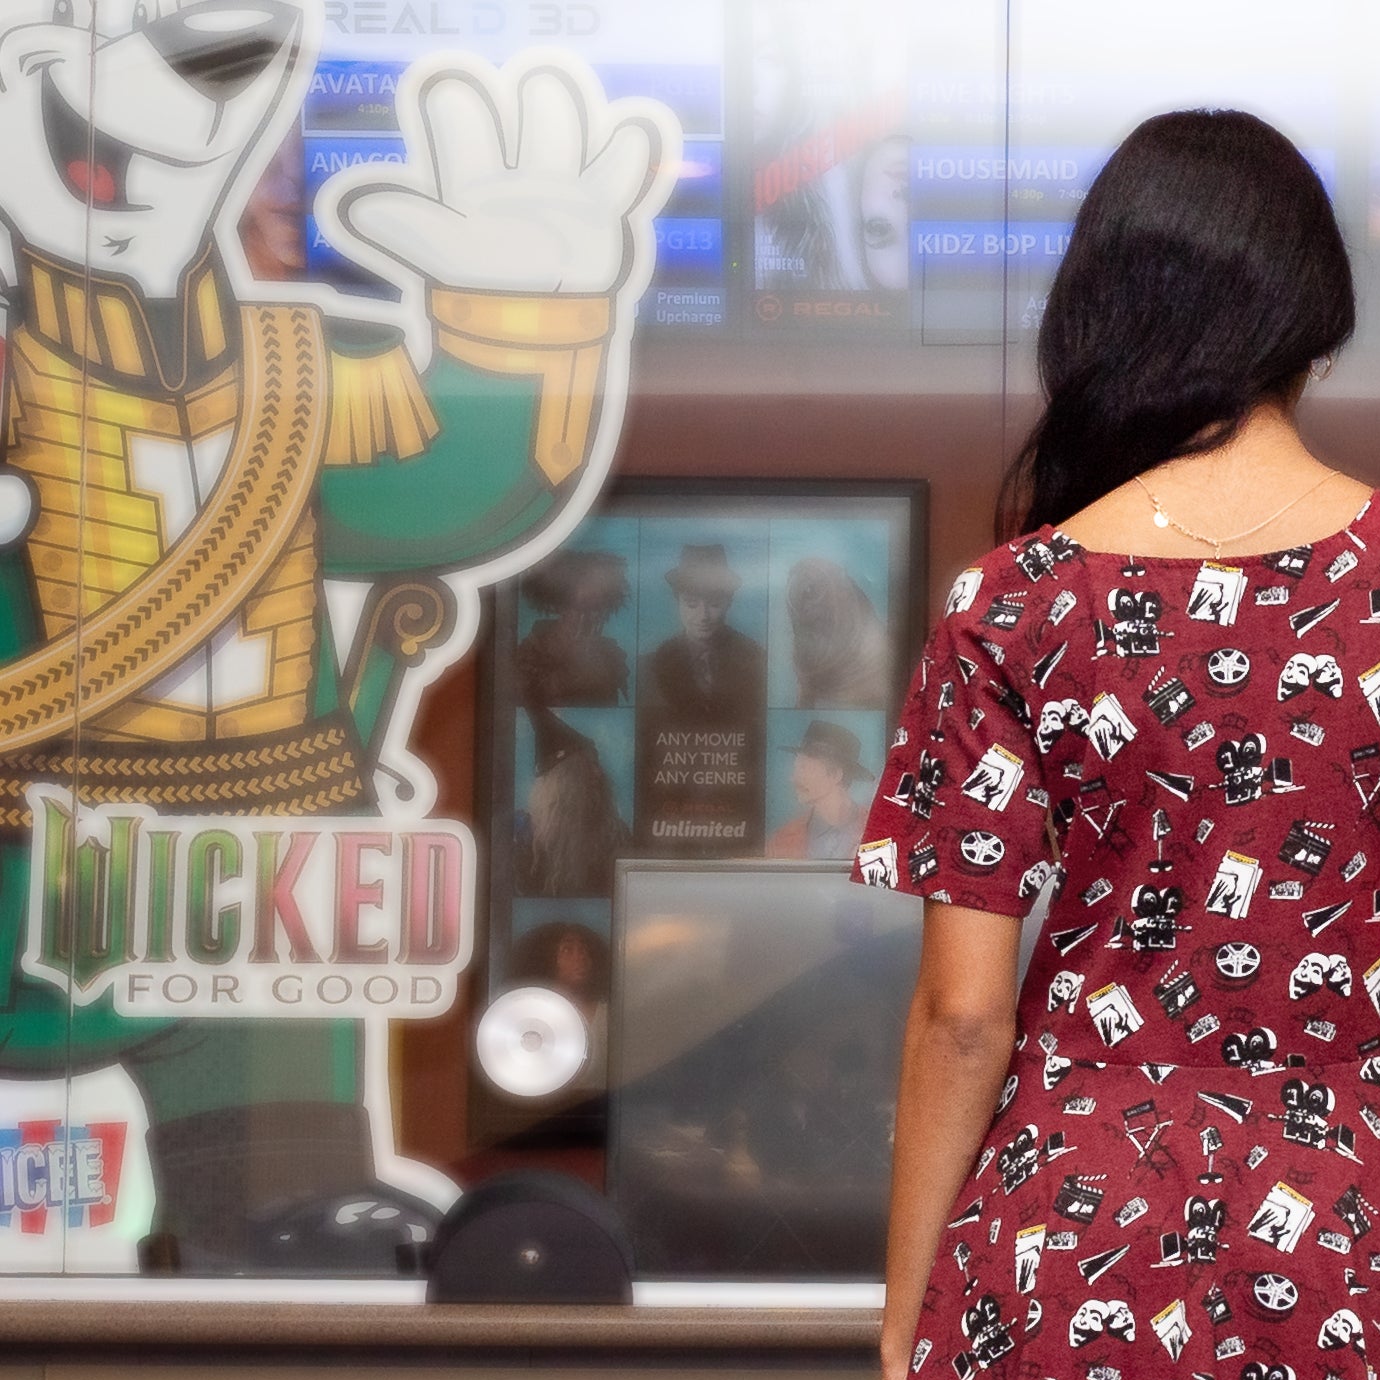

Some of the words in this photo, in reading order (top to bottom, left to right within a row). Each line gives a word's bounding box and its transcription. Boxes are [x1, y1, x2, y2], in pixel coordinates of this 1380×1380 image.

[528, 3, 601, 36] 3D
[310, 72, 401, 95] AVATA
[916, 158, 1079, 181] HOUSEMAID
[916, 233, 977, 256] KIDZ
[983, 233, 1038, 257] BOP
[1044, 233, 1071, 257] LI
[656, 291, 721, 306] Premium
[656, 310, 722, 326] Upcharge
[655, 732, 692, 747] ANY
[694, 732, 746, 747] MOVIE
[662, 751, 698, 766] ANY
[701, 751, 738, 766] TIME
[654, 771, 690, 785] ANY
[693, 771, 746, 785] GENRE
[651, 819, 747, 838] Unlimited
[35, 795, 465, 993] WICKED
[127, 973, 244, 1004] FOR
[271, 974, 443, 1005] GOOD
